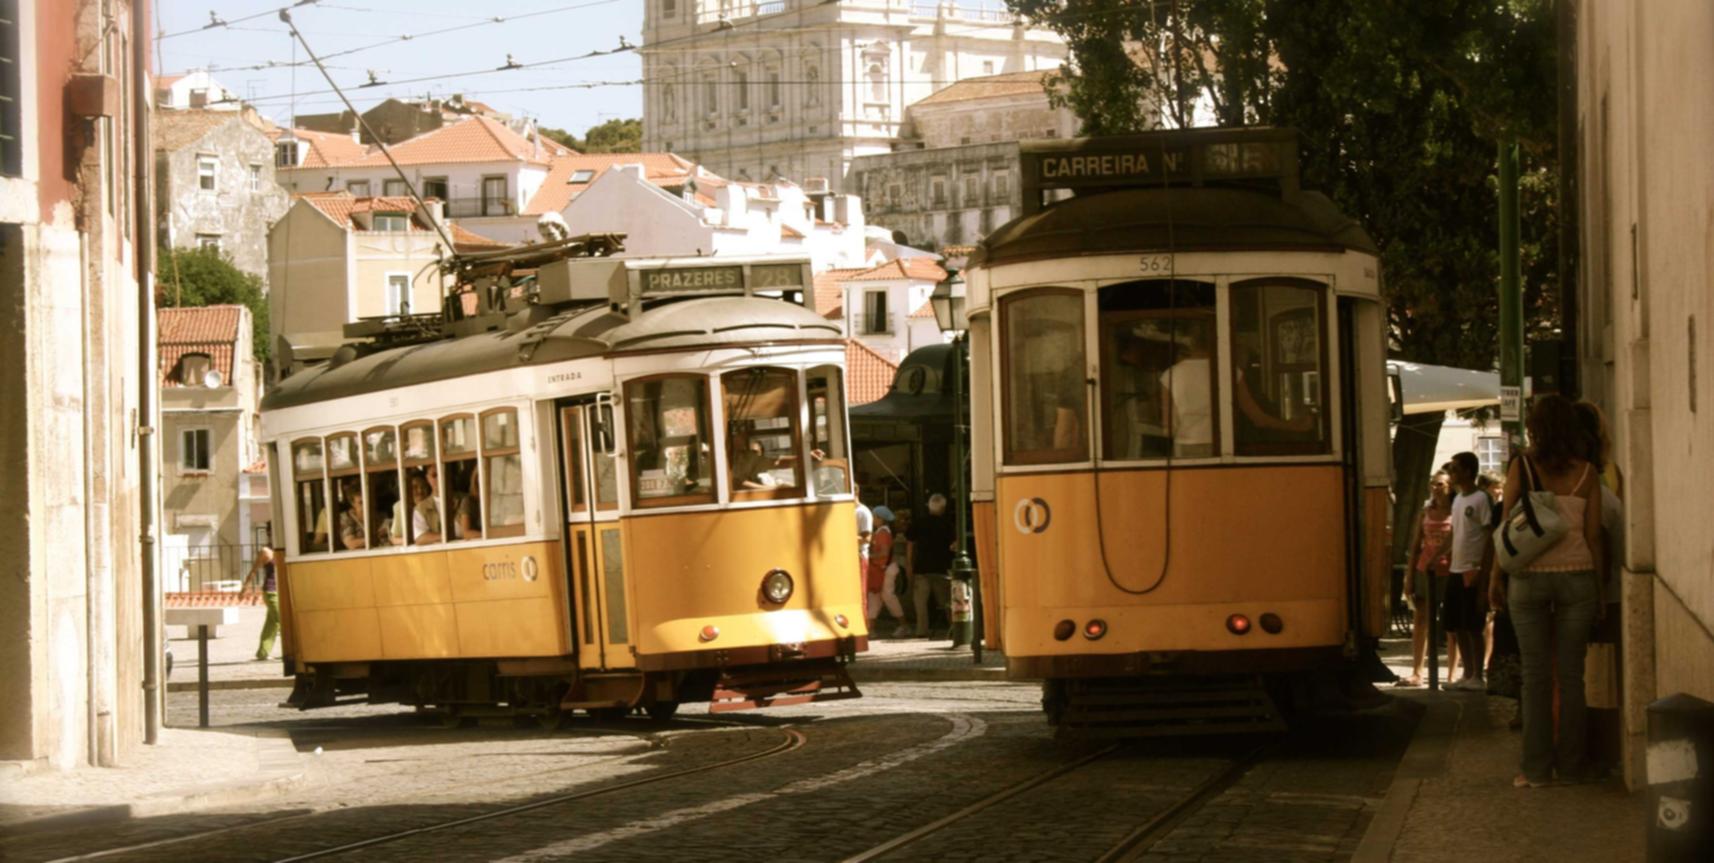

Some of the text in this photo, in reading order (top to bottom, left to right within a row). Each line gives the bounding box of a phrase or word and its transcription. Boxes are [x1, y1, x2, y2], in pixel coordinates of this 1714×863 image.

[1043, 155, 1149, 178] CARREIRA
[1140, 256, 1171, 271] 562
[649, 269, 736, 289] PRAZERES
[760, 267, 791, 287] 28
[547, 371, 582, 384] ENTRADA
[482, 553, 516, 581] carris
